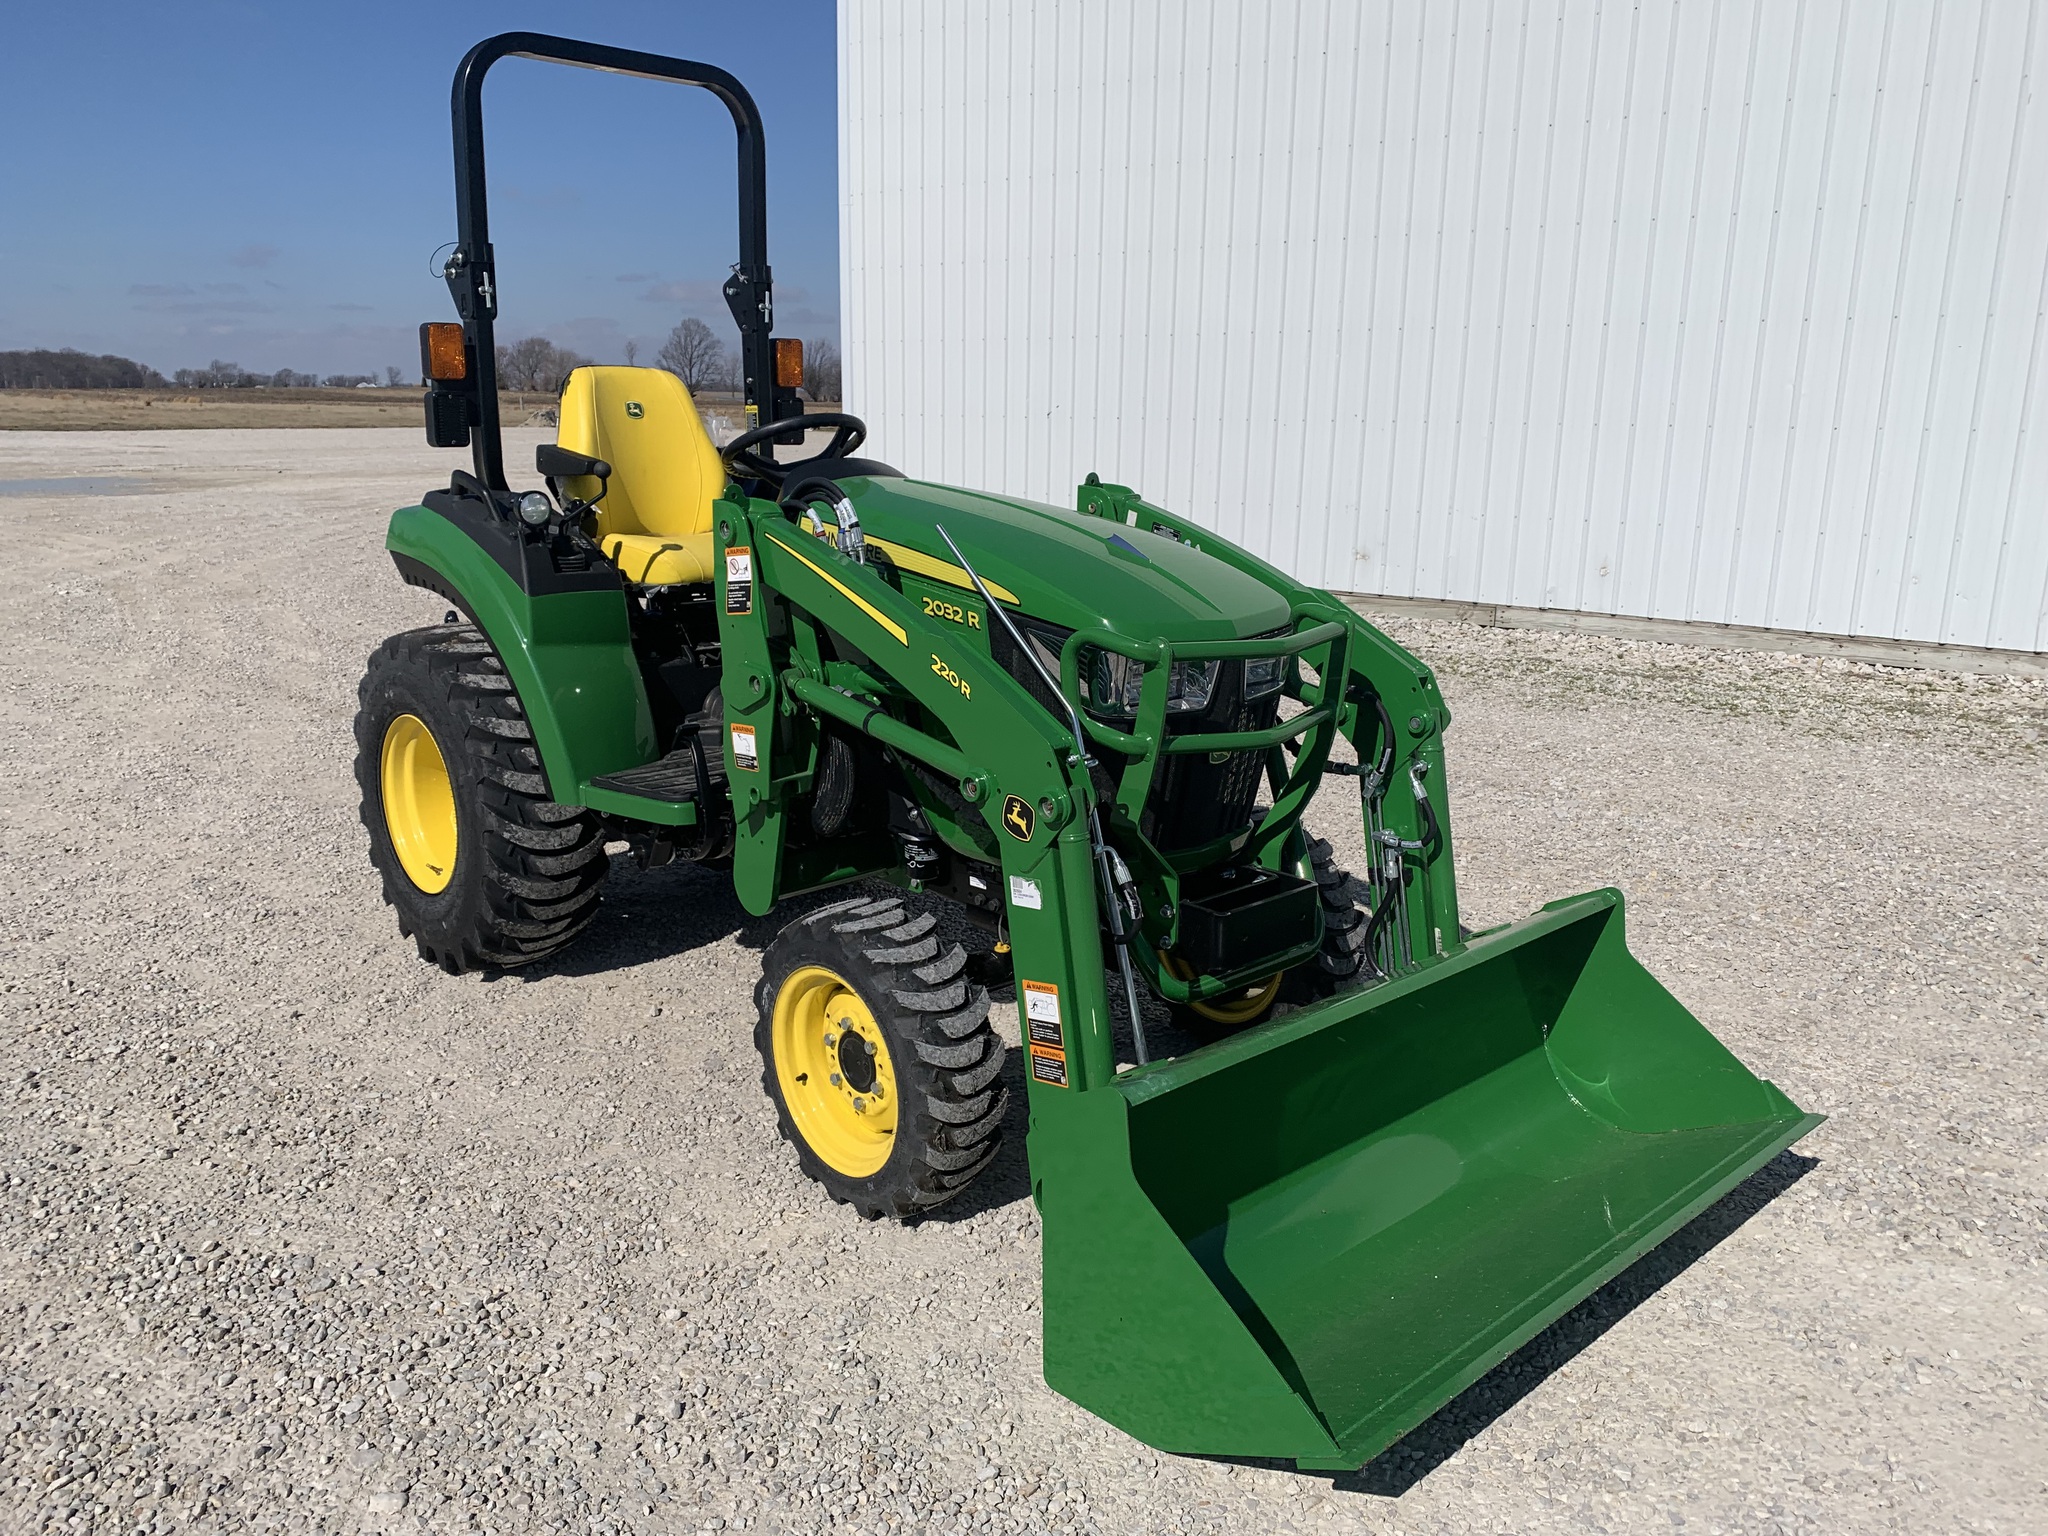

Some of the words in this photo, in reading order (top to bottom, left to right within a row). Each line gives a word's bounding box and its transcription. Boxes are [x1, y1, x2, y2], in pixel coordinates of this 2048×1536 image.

[922, 597, 964, 625] 2032
[967, 610, 981, 630] R
[931, 654, 959, 688] 220
[961, 679, 971, 701] R
[1032, 984, 1054, 993] WARNING
[1039, 1049, 1062, 1059] WARNING
